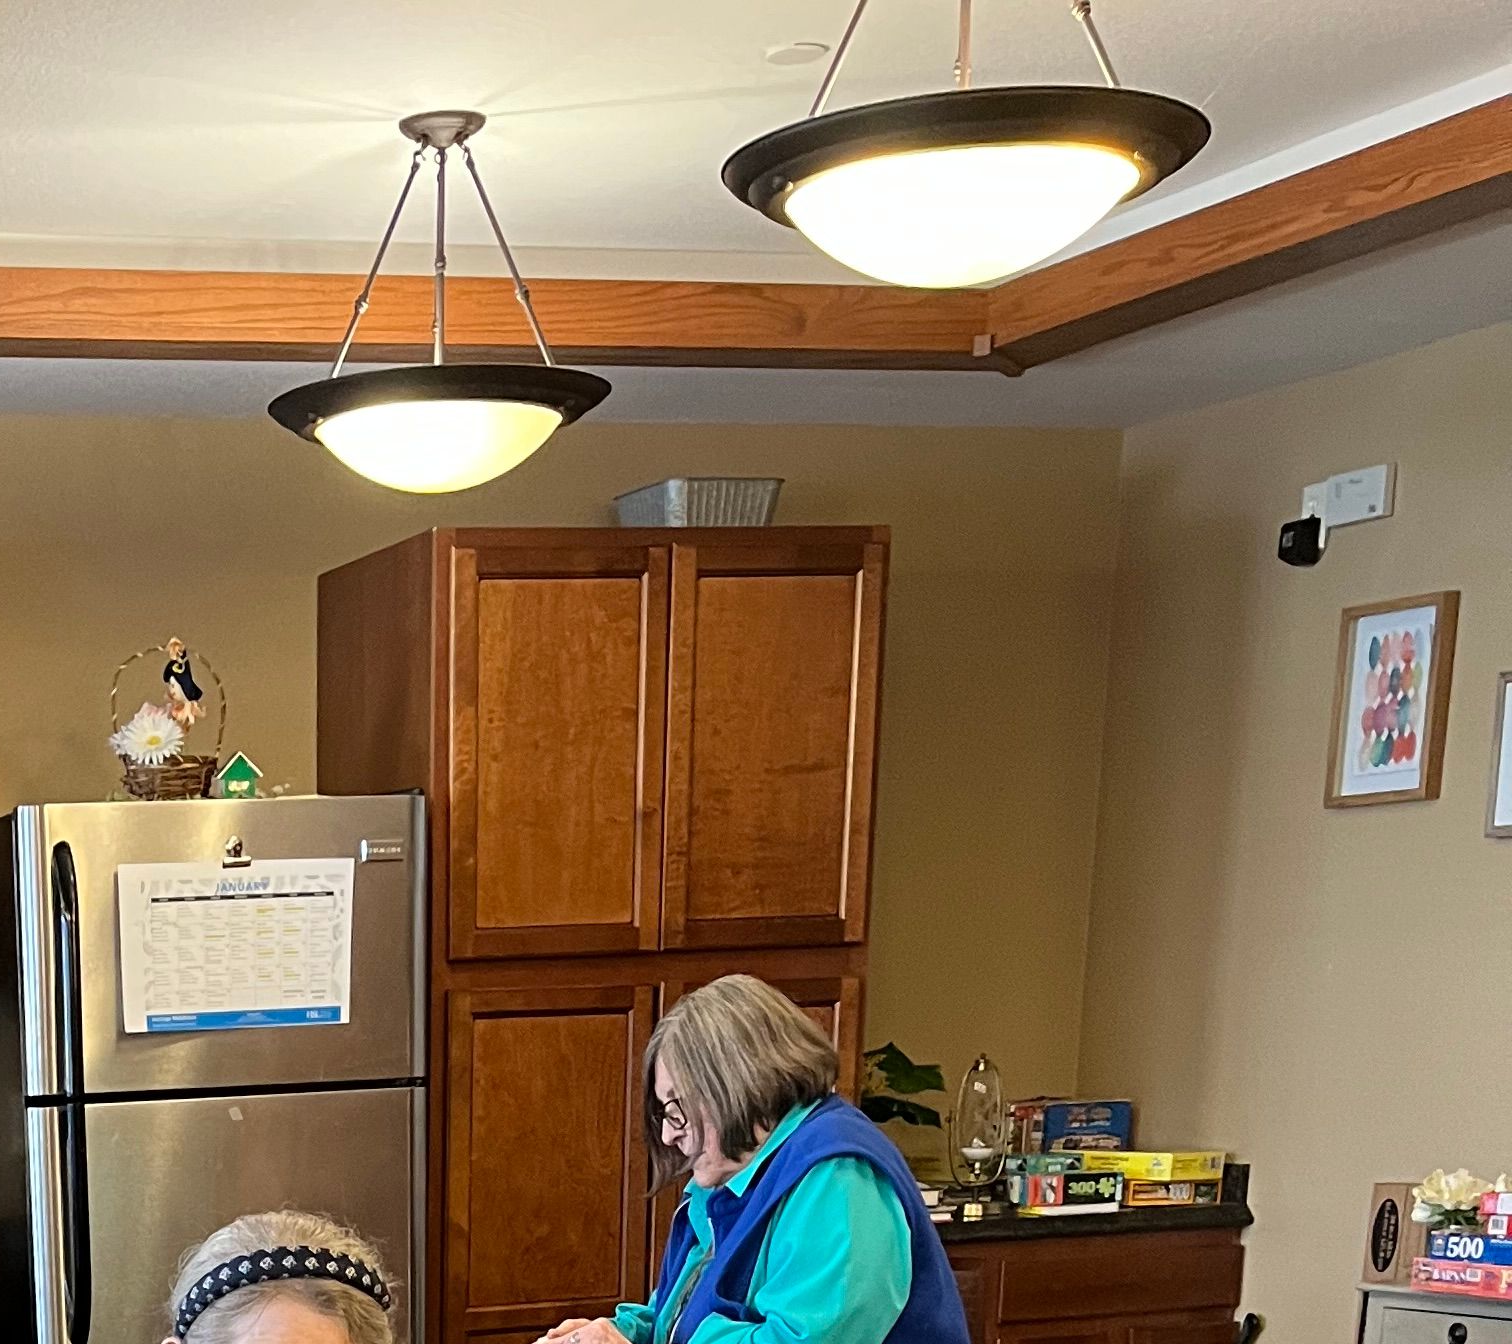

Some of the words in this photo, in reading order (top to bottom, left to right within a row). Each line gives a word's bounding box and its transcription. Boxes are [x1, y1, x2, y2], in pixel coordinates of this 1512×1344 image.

[214, 877, 270, 894] JANUARY
[1068, 1181, 1096, 1195] 300
[1446, 1236, 1484, 1259] 500
